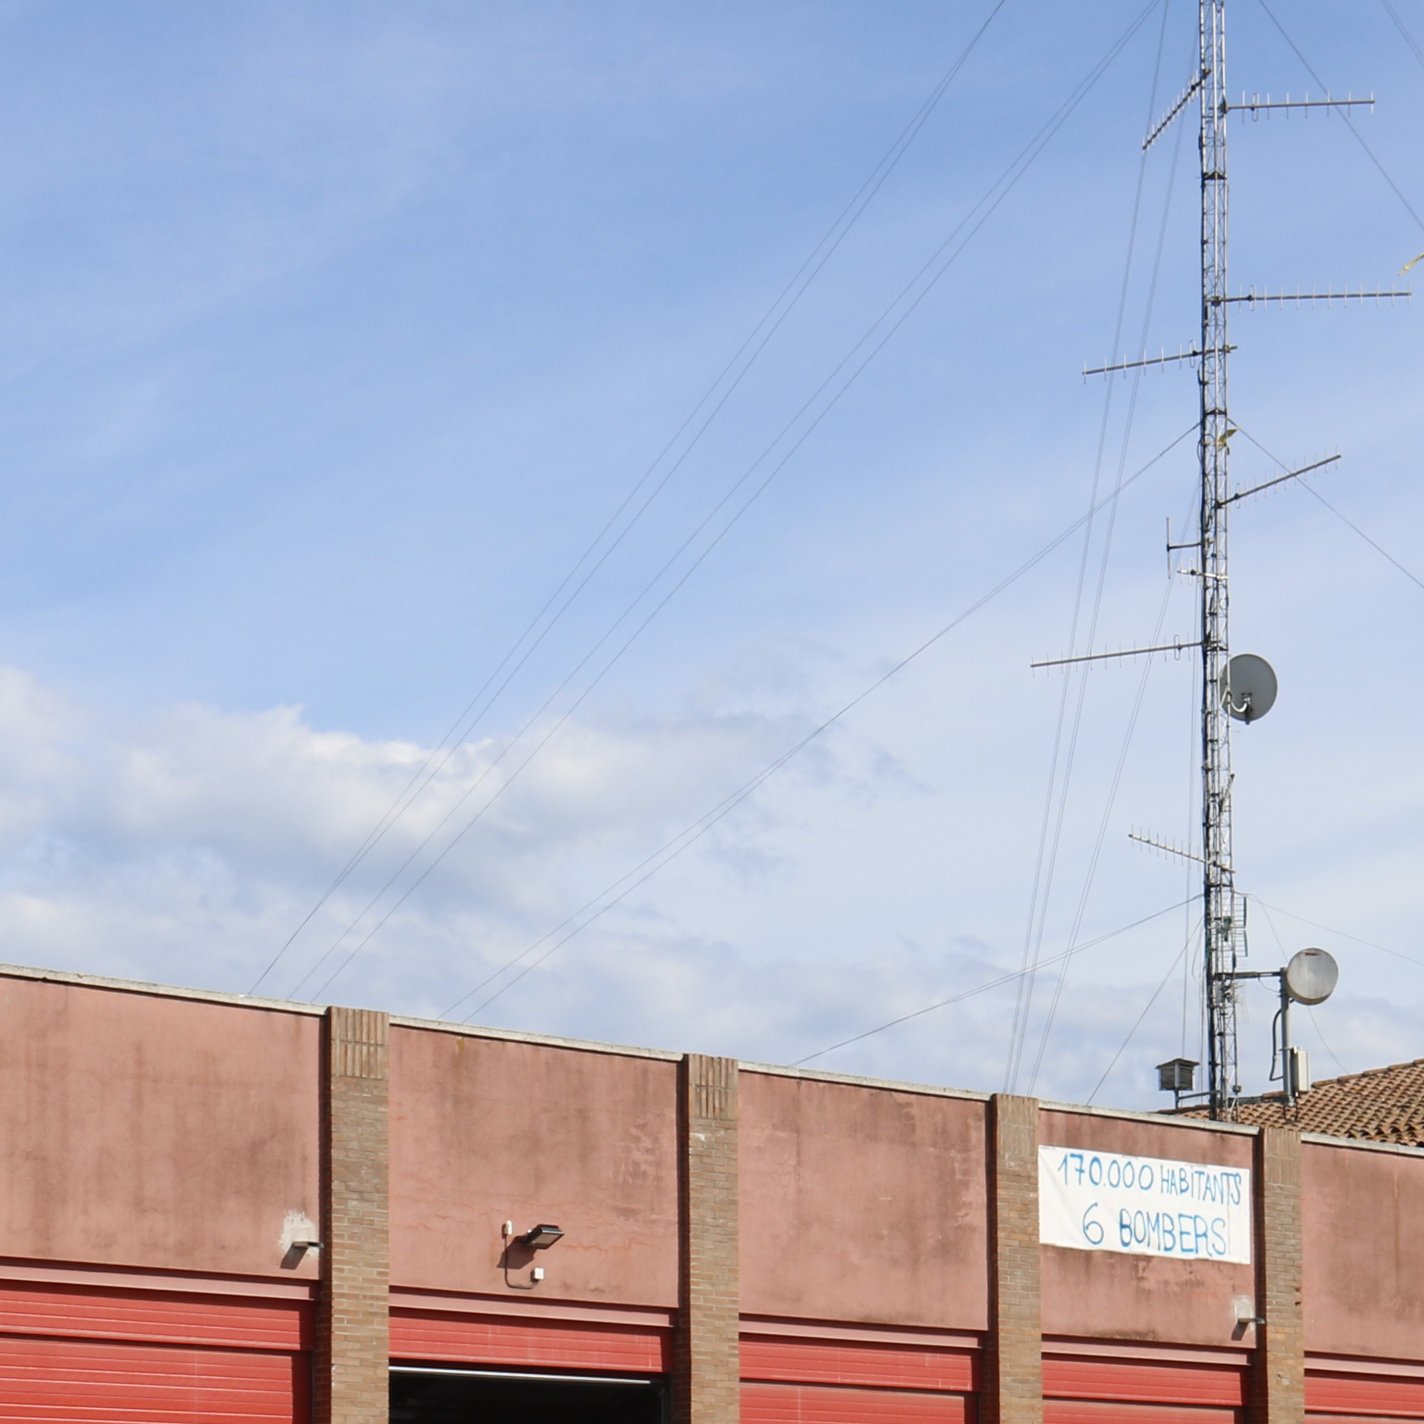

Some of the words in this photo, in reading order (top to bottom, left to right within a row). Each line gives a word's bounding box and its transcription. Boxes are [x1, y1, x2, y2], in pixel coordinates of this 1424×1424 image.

[1057, 1153, 1154, 1191] 170.000
[1082, 1202, 1104, 1245] 6
[1119, 1208, 1226, 1257] BOMBERS
